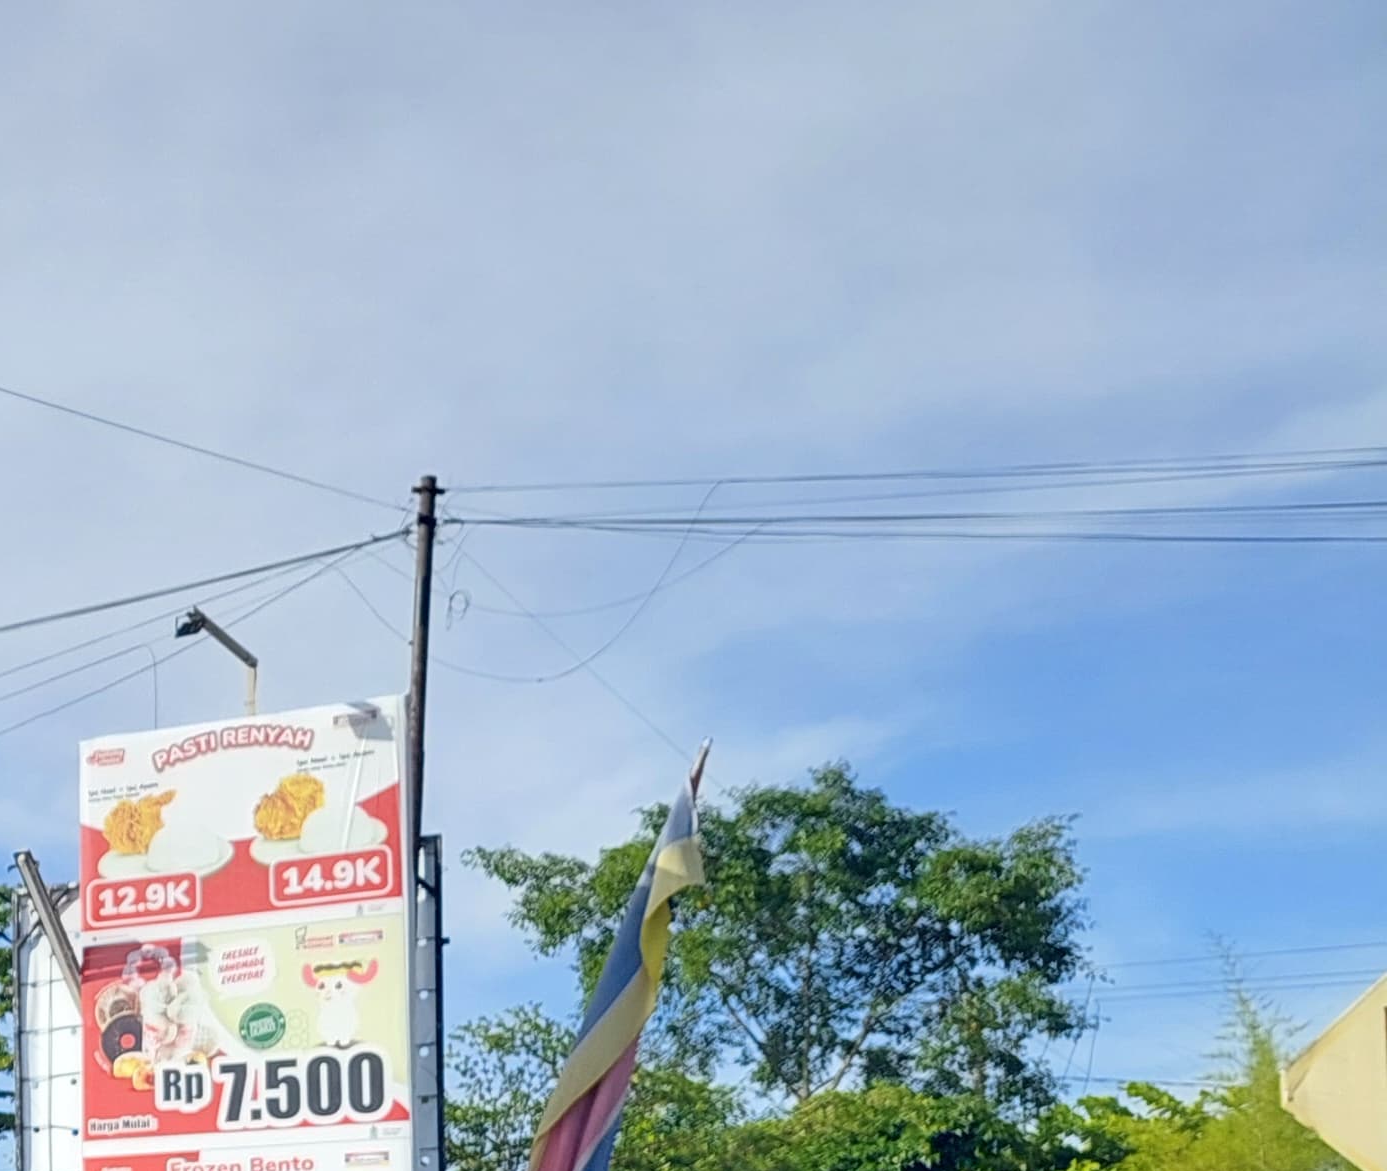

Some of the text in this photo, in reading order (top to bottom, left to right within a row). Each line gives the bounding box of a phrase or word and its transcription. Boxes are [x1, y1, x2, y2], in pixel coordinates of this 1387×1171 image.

[153, 729, 217, 772] PASTI
[222, 724, 314, 750] RENYAH
[282, 857, 381, 895] 14.9K
[98, 881, 191, 916] 12.9K
[163, 1052, 385, 1122] Rp 7.500
